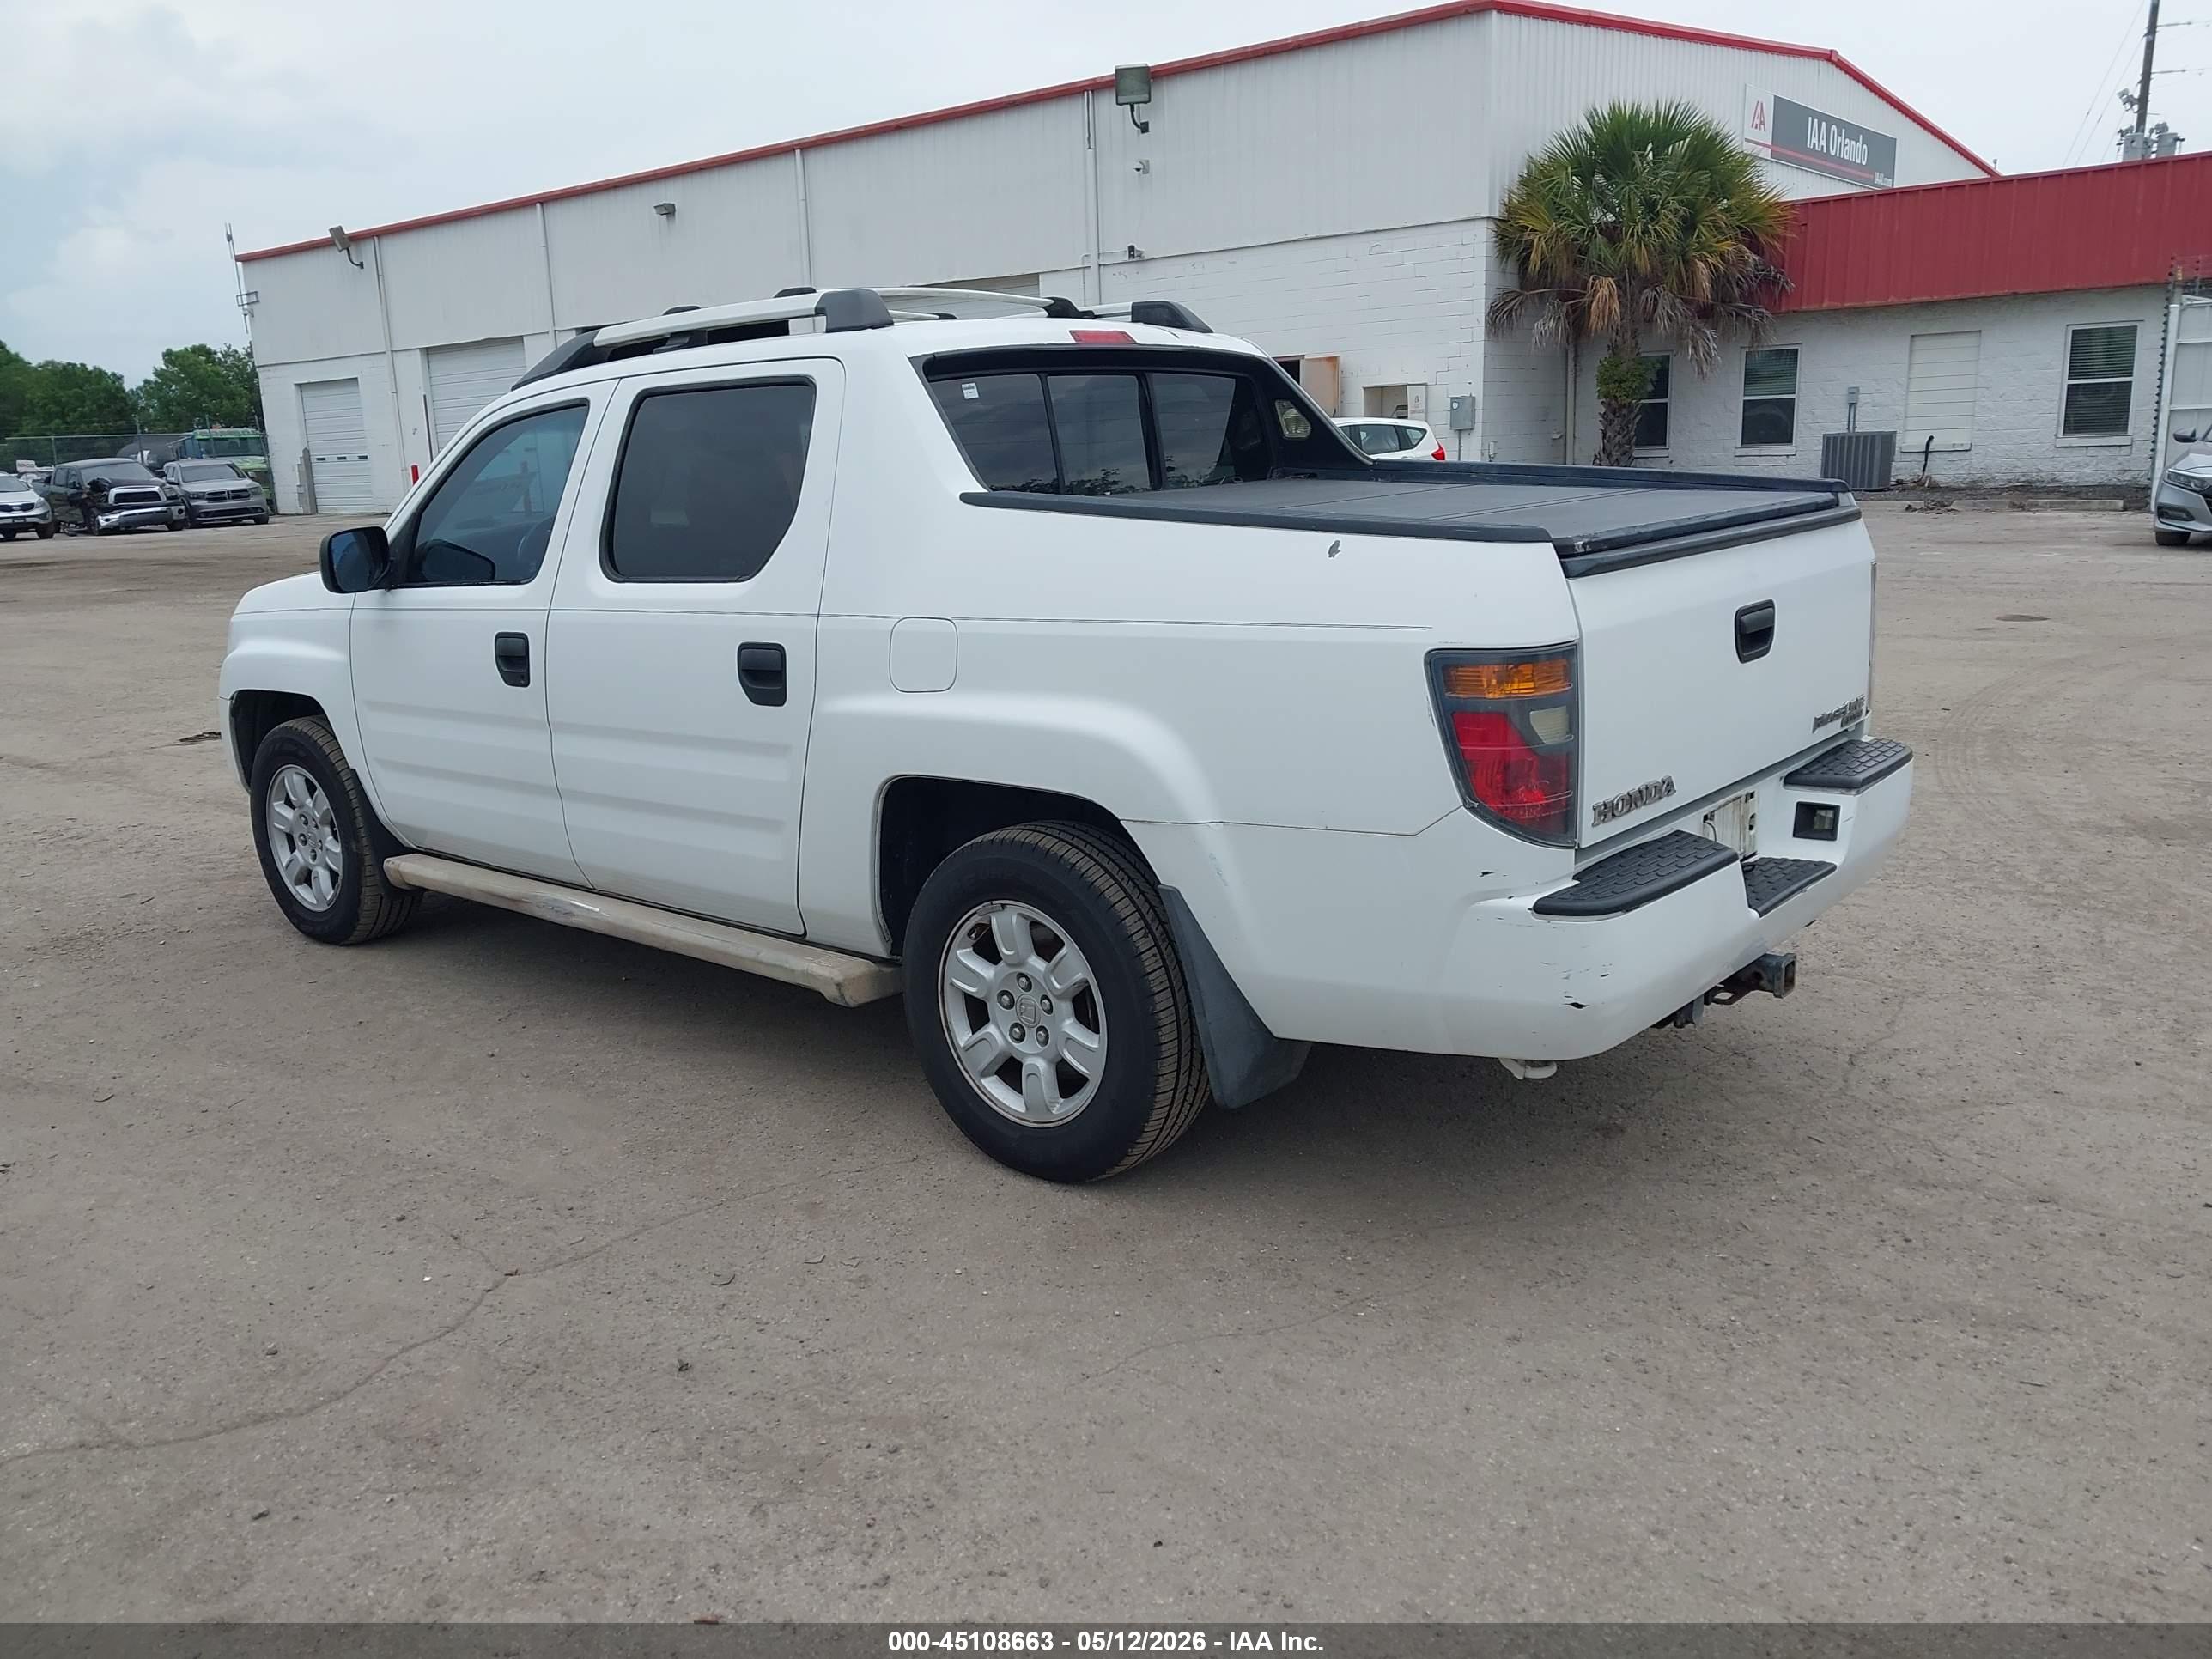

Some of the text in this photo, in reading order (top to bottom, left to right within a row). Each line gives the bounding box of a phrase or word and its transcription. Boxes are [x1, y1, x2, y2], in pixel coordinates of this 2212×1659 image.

[1806, 116, 1869, 166] IAA Orlando
[1591, 775, 1677, 828] HONDA
